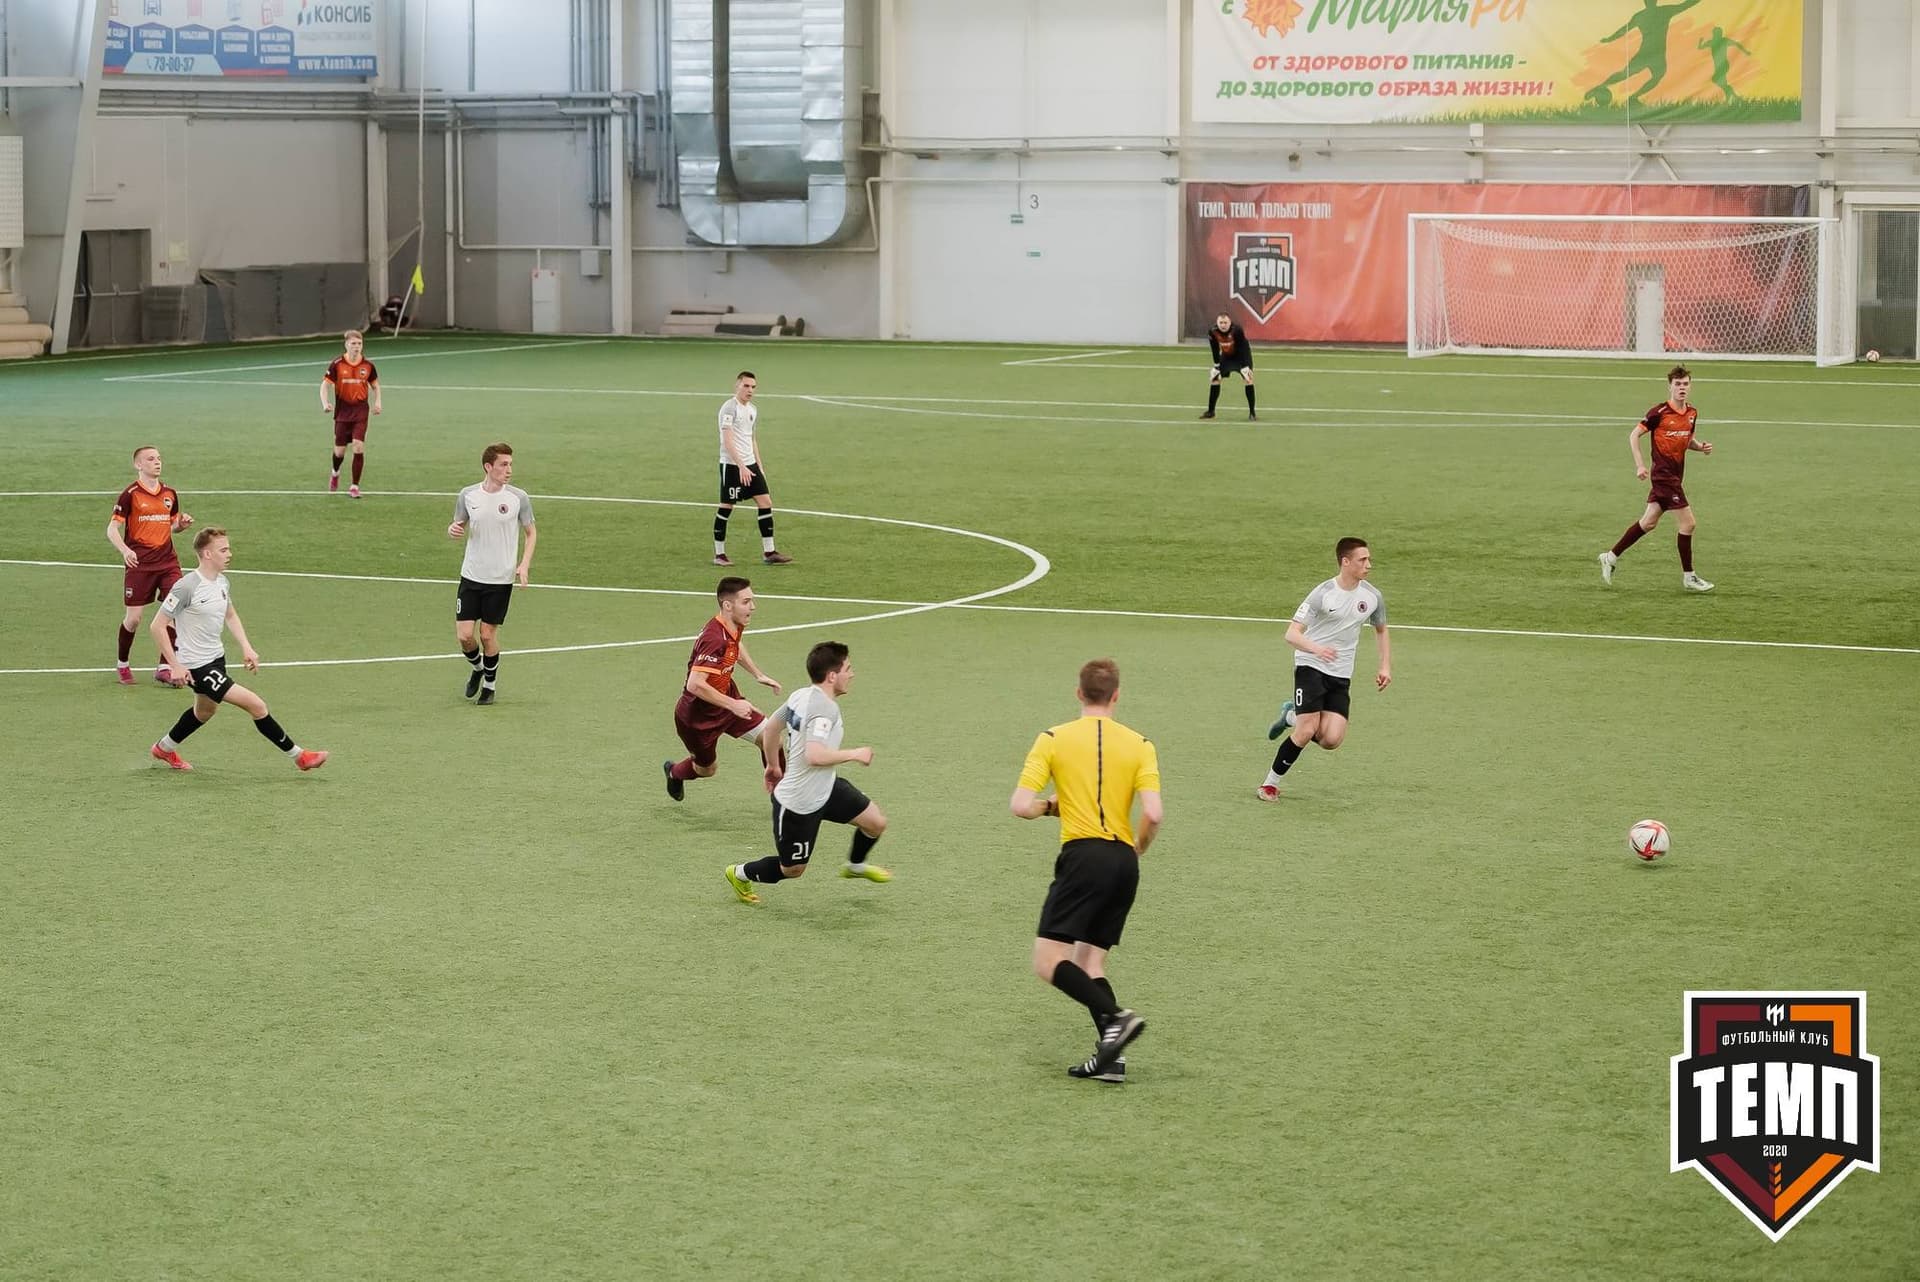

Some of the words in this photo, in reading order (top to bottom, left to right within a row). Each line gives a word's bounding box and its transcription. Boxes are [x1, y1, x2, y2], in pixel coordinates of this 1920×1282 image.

[314, 5, 372, 23] КОНСИБ
[1253, 55, 1280, 70] ОТ
[1284, 55, 1408, 73] ЗДОРОВОГО
[1412, 54, 1514, 70] ПИТАНИЯ
[1216, 80, 1247, 98] ДО
[1250, 81, 1374, 98] ЗДОРОВОГО
[1378, 81, 1458, 96] ОБРАЗА
[1030, 194, 1039, 209] 3
[1198, 201, 1227, 219] ТЕМП,
[1229, 202, 1259, 219] ТЕМП,
[1261, 202, 1299, 218] ТОЛЬКО
[1302, 203, 1332, 219] ТЕМП!
[1236, 258, 1290, 290] ТЕМП
[203, 669, 227, 692] 22
[1296, 689, 1303, 706] 8
[791, 842, 809, 860] 21
